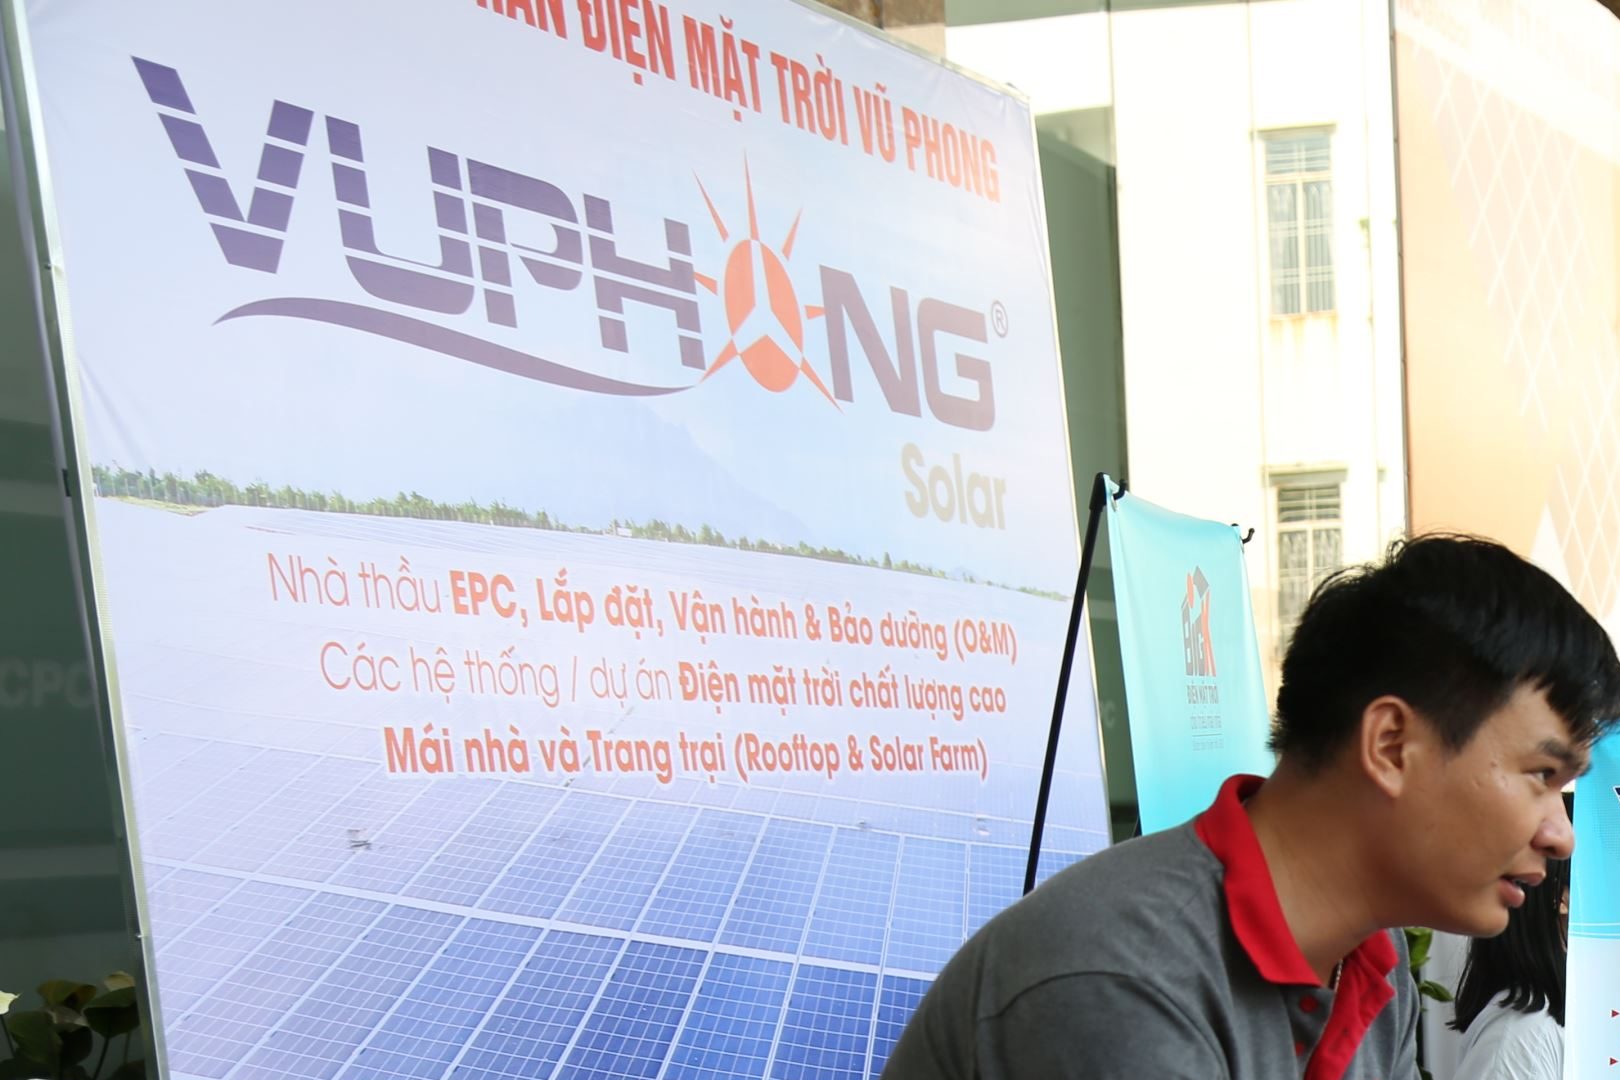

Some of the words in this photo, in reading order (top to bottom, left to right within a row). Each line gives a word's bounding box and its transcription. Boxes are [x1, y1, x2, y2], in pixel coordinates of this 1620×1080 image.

[682, 14, 761, 122] MẶT
[770, 53, 849, 146] TRỜI
[852, 82, 897, 163] VŨ
[901, 106, 1001, 203] PHONG
[130, 55, 998, 433] VUPHONG
[901, 443, 1006, 531] Solar
[267, 553, 350, 606] Nhà
[358, 555, 441, 613] thầu
[449, 570, 528, 628] EPC,
[536, 567, 595, 633] Lắp
[604, 583, 664, 641] đặt,
[668, 589, 726, 645] Vận
[732, 595, 798, 640] hành
[804, 602, 822, 641] &
[827, 601, 873, 645] Bảo
[954, 618, 1018, 665] (O&M)
[320, 641, 401, 692] Các
[410, 647, 456, 704] hệ
[464, 645, 560, 708] thống
[590, 657, 628, 708] dự
[636, 658, 672, 701] án
[678, 660, 741, 714] Điện
[748, 664, 797, 716] mặt
[803, 667, 844, 707] trời
[850, 664, 900, 709] chất
[904, 674, 965, 721] lượng
[968, 685, 1007, 714] cao
[384, 722, 455, 774] Mái
[464, 724, 530, 774] nhà
[538, 725, 581, 773] và
[586, 730, 673, 785] Trang
[679, 731, 727, 783] trại
[734, 732, 840, 783] (Rooftop
[847, 733, 865, 772] &
[869, 736, 925, 772] Solar
[929, 737, 988, 782] Farm)
